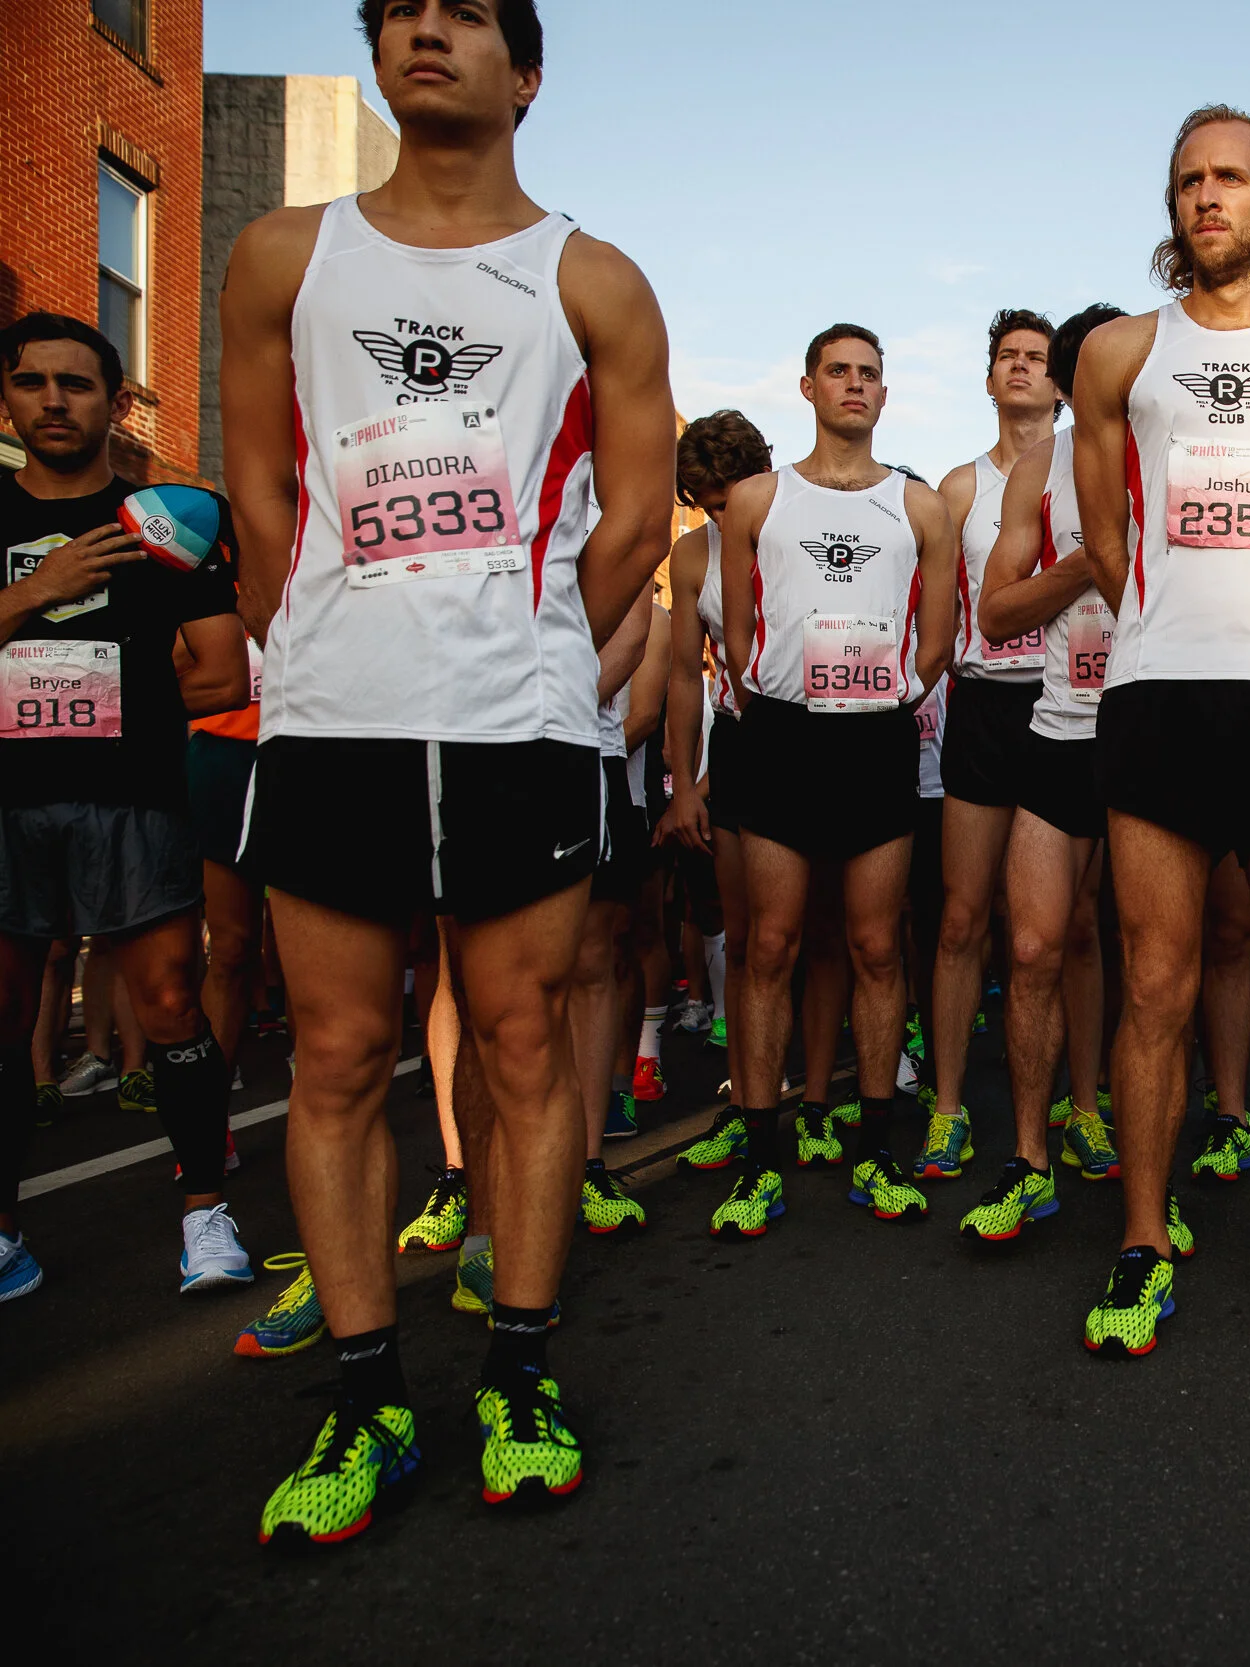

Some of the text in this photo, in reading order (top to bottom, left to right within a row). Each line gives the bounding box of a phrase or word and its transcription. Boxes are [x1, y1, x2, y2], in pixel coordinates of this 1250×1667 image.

[476, 262, 537, 298] DIADORA
[394, 318, 465, 341] TRACK
[1202, 363, 1250, 373] TRACK
[465, 414, 480, 428] A
[1208, 413, 1245, 424] CLUB
[357, 414, 407, 446] PHILLY 10
[1191, 445, 1227, 457] PHILLY
[366, 455, 478, 488] DIADORA
[869, 498, 900, 523] DIADORA
[351, 488, 505, 549] 5333
[145, 524, 165, 542] MICH
[153, 518, 171, 536] RUN
[822, 532, 860, 543] TRACK
[487, 559, 516, 570] 5333
[824, 573, 853, 583] CLUB
[1081, 603, 1104, 616] PHILLY
[819, 620, 846, 630] PHILLY
[1102, 631, 1113, 642] P
[12, 646, 45, 659] PHILLY
[95, 648, 107, 658] A
[844, 645, 861, 657] PR
[30, 676, 82, 692] Bryce
[811, 665, 891, 691] 5346
[17, 698, 96, 728] 918
